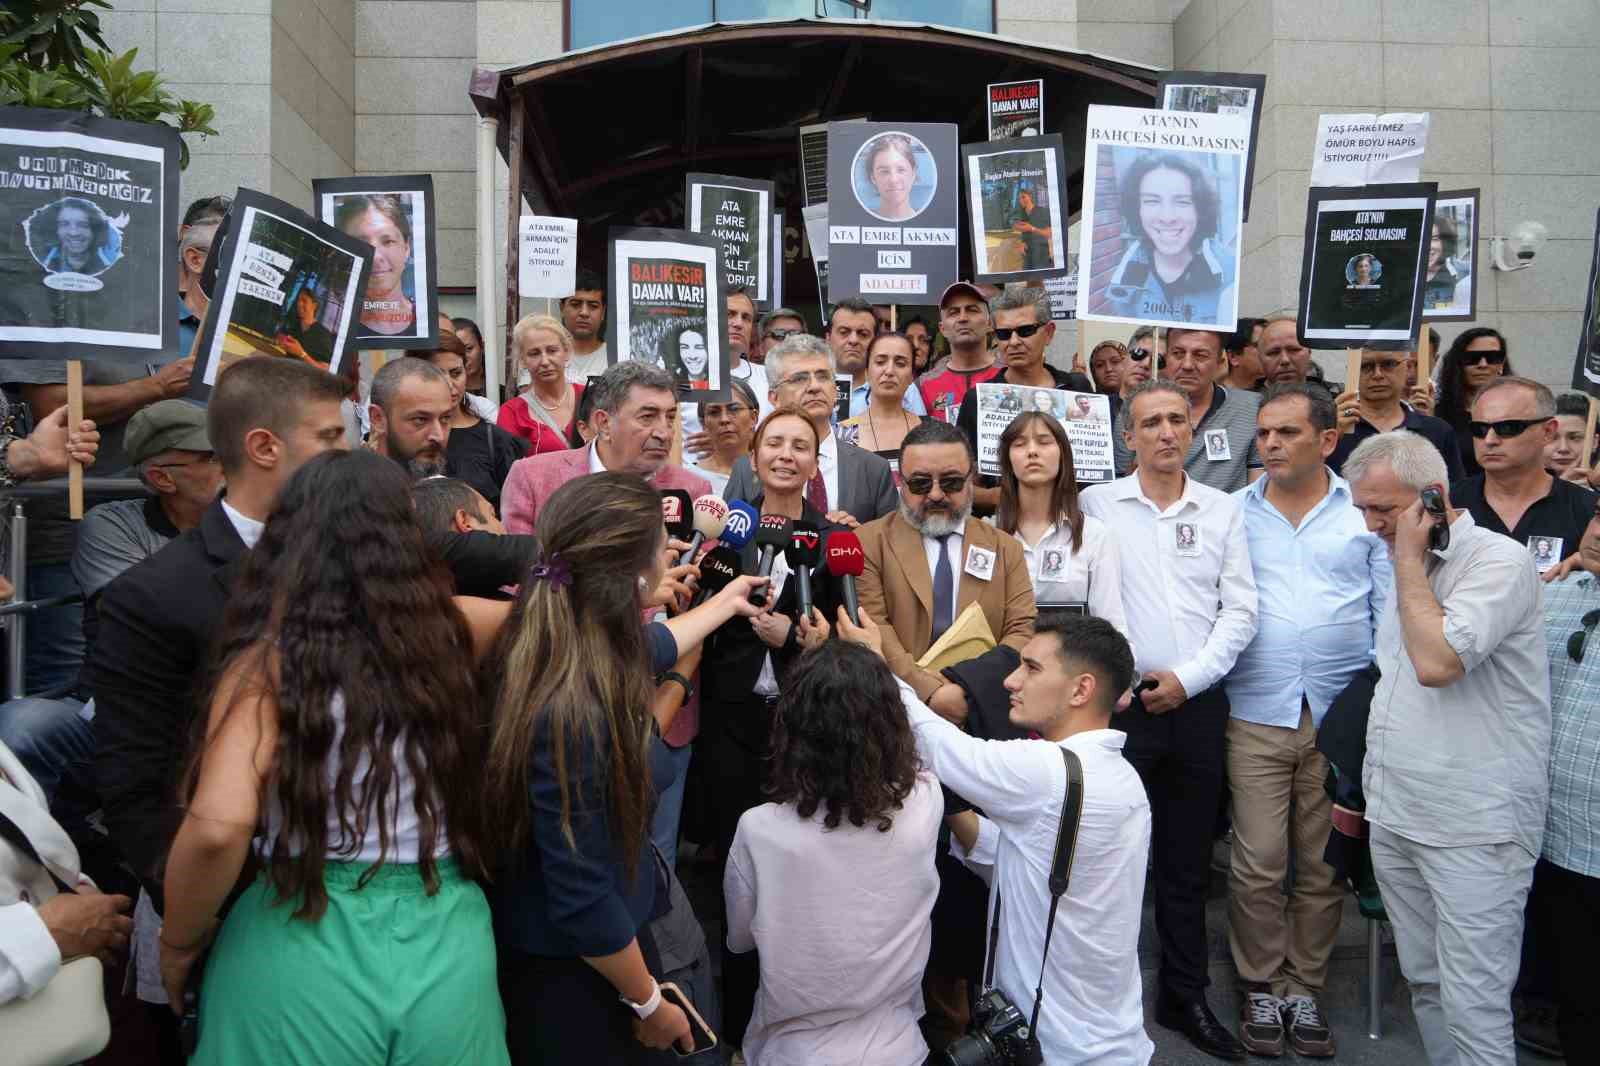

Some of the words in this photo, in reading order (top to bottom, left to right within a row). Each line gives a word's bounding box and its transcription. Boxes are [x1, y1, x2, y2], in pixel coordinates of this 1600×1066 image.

[992, 100, 1018, 113] DAVAN
[1019, 98, 1039, 111] VAR!
[1328, 125, 1345, 134] YAŞ
[1347, 123, 1404, 132] FARKETMEZ
[1090, 128, 1157, 144] BAHÇESİ
[1160, 133, 1245, 151] SOLMASIN!
[1358, 138, 1385, 147] BOYU
[1387, 136, 1416, 147] HAPİS
[721, 200, 740, 212] ATA
[528, 223, 543, 231] ATA
[715, 214, 745, 228] EMRE
[711, 229, 749, 243] AKMAN
[832, 231, 855, 241] ATA
[864, 231, 898, 241] EMRE
[905, 232, 951, 243] AKMAN
[1330, 227, 1364, 244] BAHÇESİ
[1364, 228, 1407, 241] SOLMASIN!
[723, 242, 740, 257] ÇİN
[725, 260, 751, 272] ALET
[880, 252, 905, 266] İÇİN
[631, 262, 704, 285] BALIKESİR
[727, 273, 756, 287] ORUZ
[863, 278, 922, 289] ADALET!
[632, 283, 673, 300] DAVAN
[677, 285, 704, 303] VAR!
[985, 413, 1015, 422] ADALE
[830, 547, 862, 557] DHA
